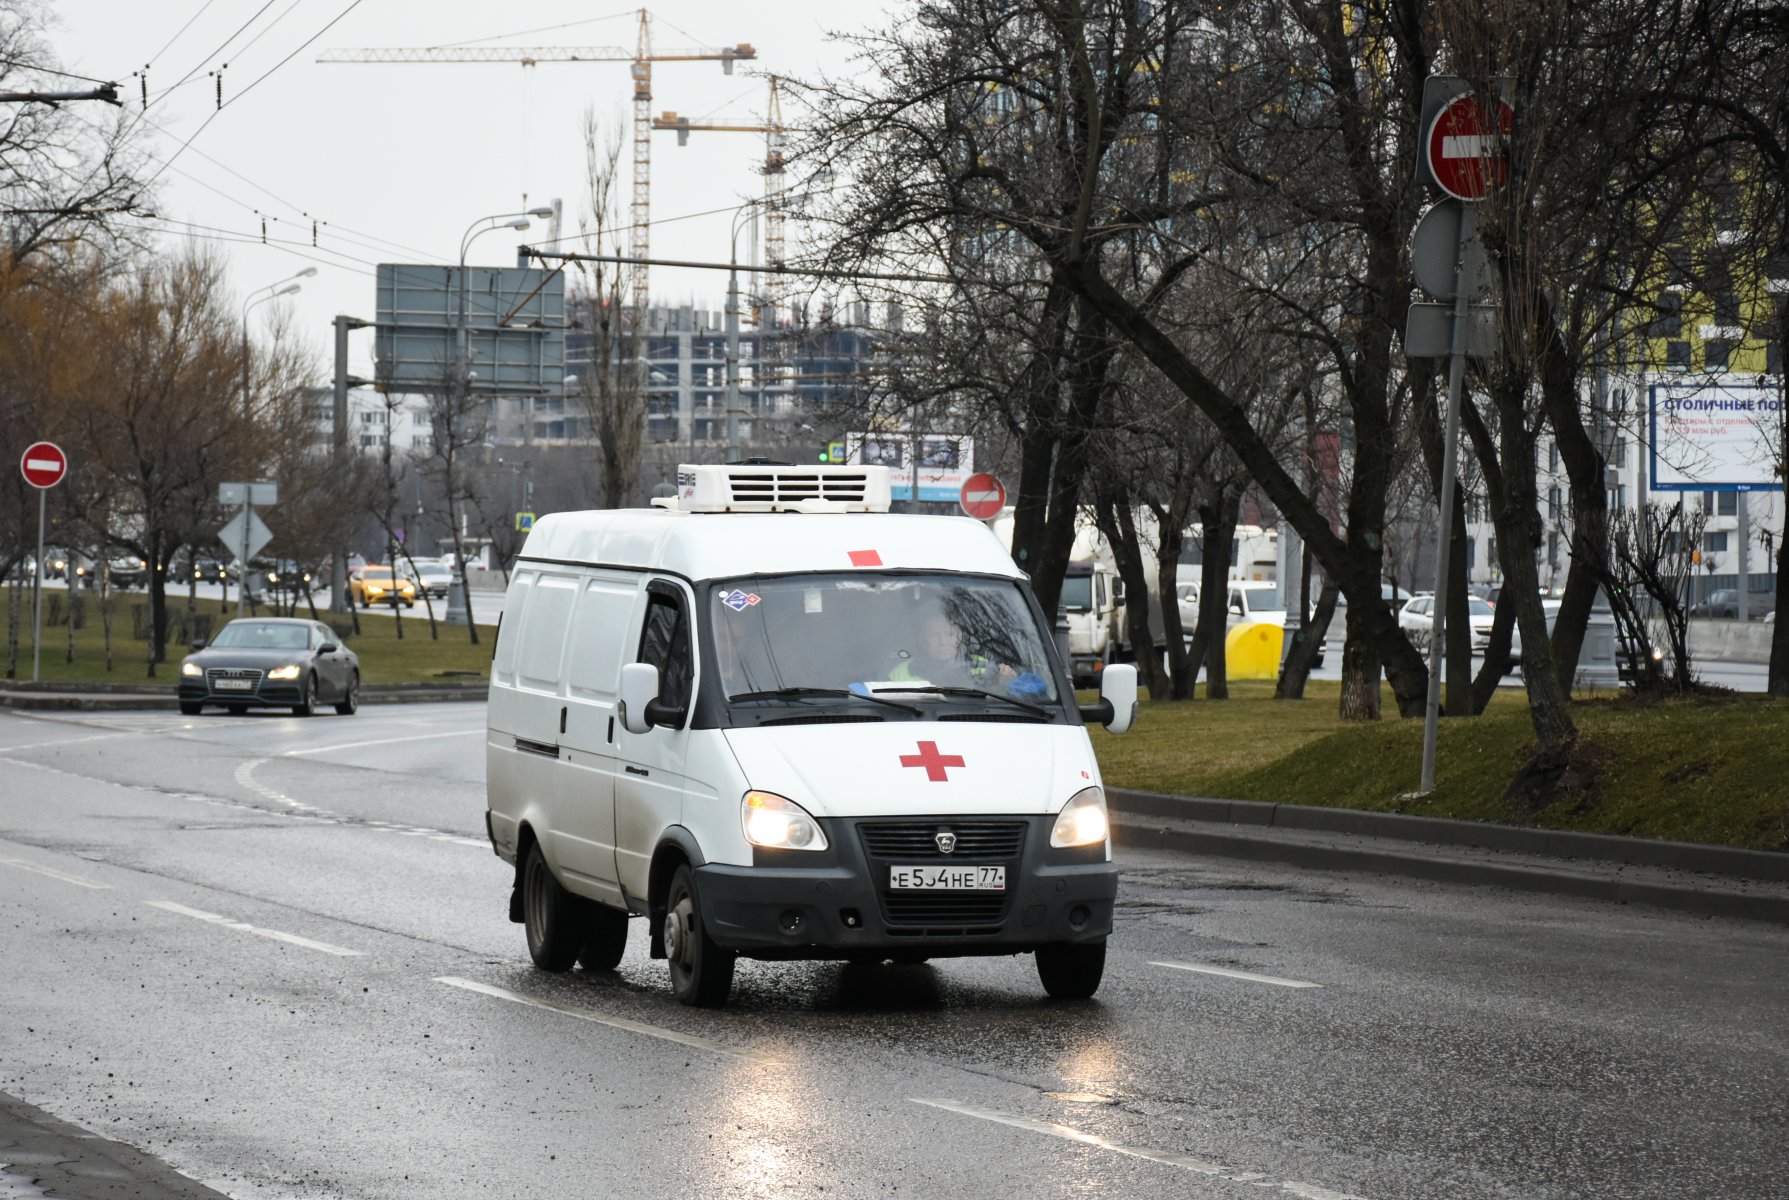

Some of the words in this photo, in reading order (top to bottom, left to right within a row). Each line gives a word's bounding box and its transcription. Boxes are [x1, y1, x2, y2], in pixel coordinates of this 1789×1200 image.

[1664, 399, 1755, 411] СТОЛИЧНЫЕ
[1758, 400, 1783, 411] ПО
[980, 868, 999, 883] 77
